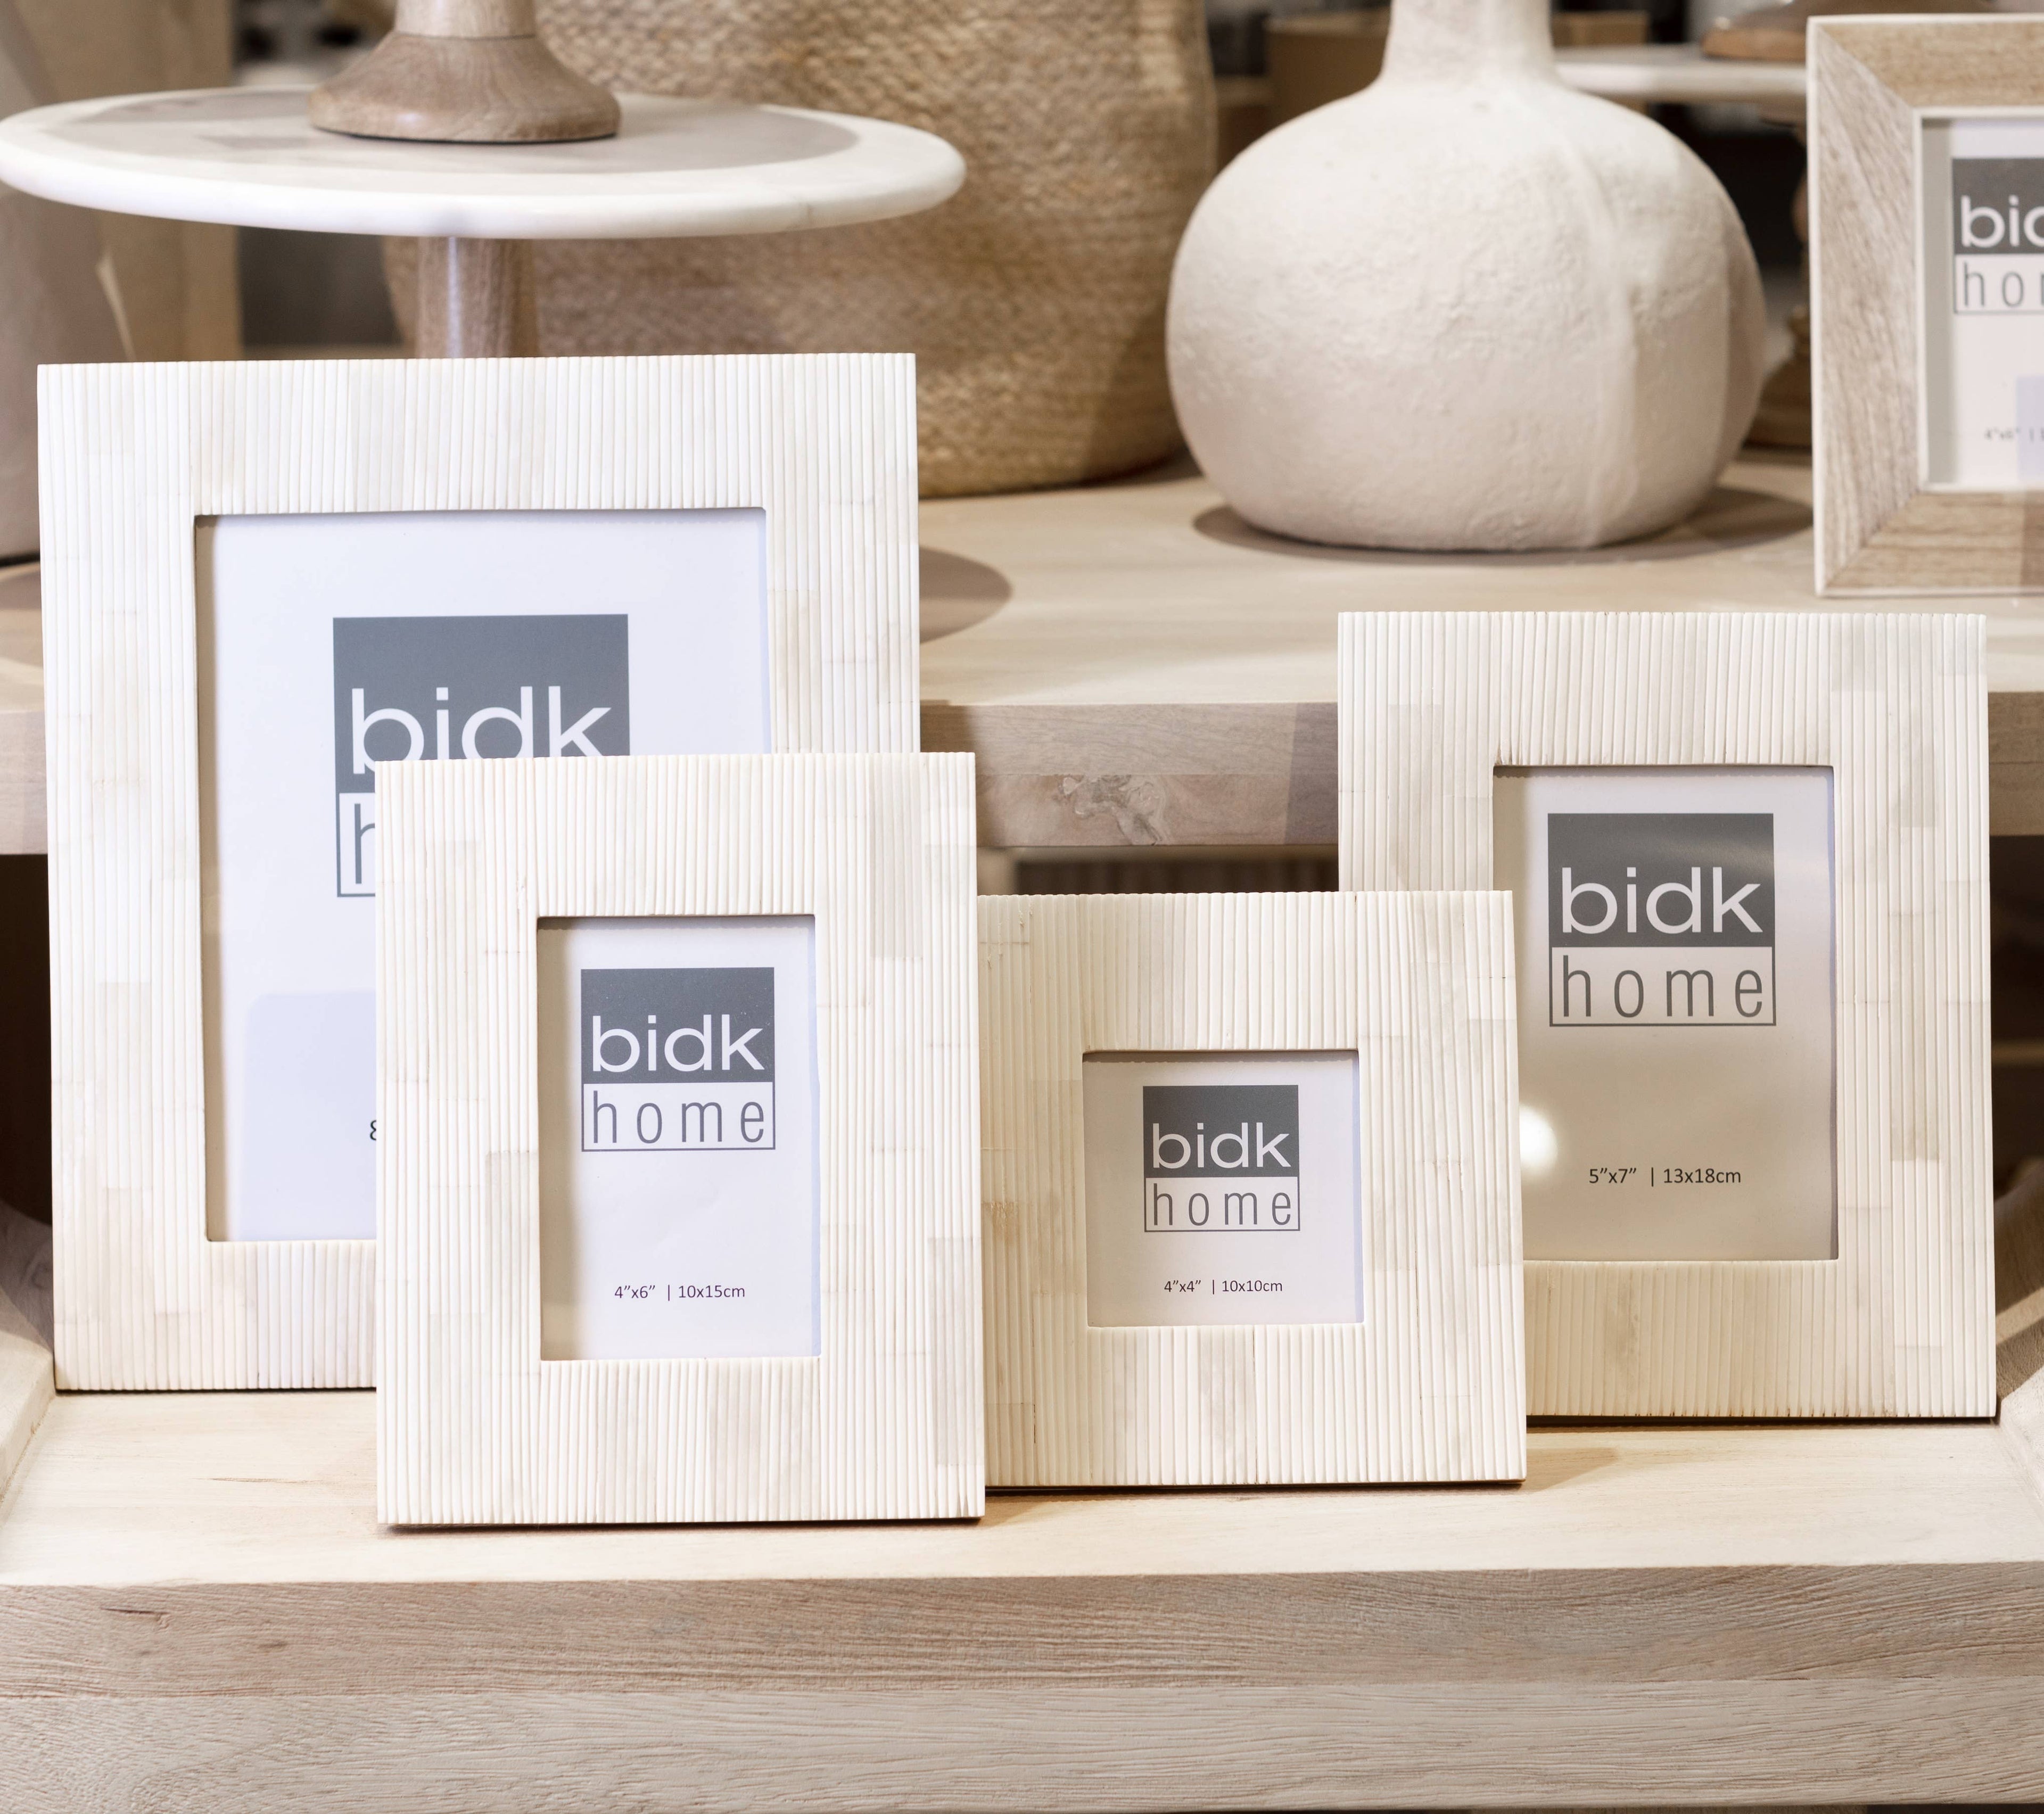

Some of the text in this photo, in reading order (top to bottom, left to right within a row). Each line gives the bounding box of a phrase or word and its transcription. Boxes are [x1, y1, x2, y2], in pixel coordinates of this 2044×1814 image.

[1963, 261, 2044, 308] ho
[351, 686, 612, 774] bidk
[1561, 867, 1763, 935] bidk
[1563, 955, 1762, 1018] home
[592, 1014, 765, 1073] bidk
[592, 1090, 764, 1144] home
[1152, 1122, 1292, 1169] bidk
[1663, 1167, 1742, 1184] 13x18cm
[1153, 1182, 1291, 1226] home
[678, 1284, 745, 1299] 10x15cm
[1222, 1280, 1283, 1292] 10x10cm
